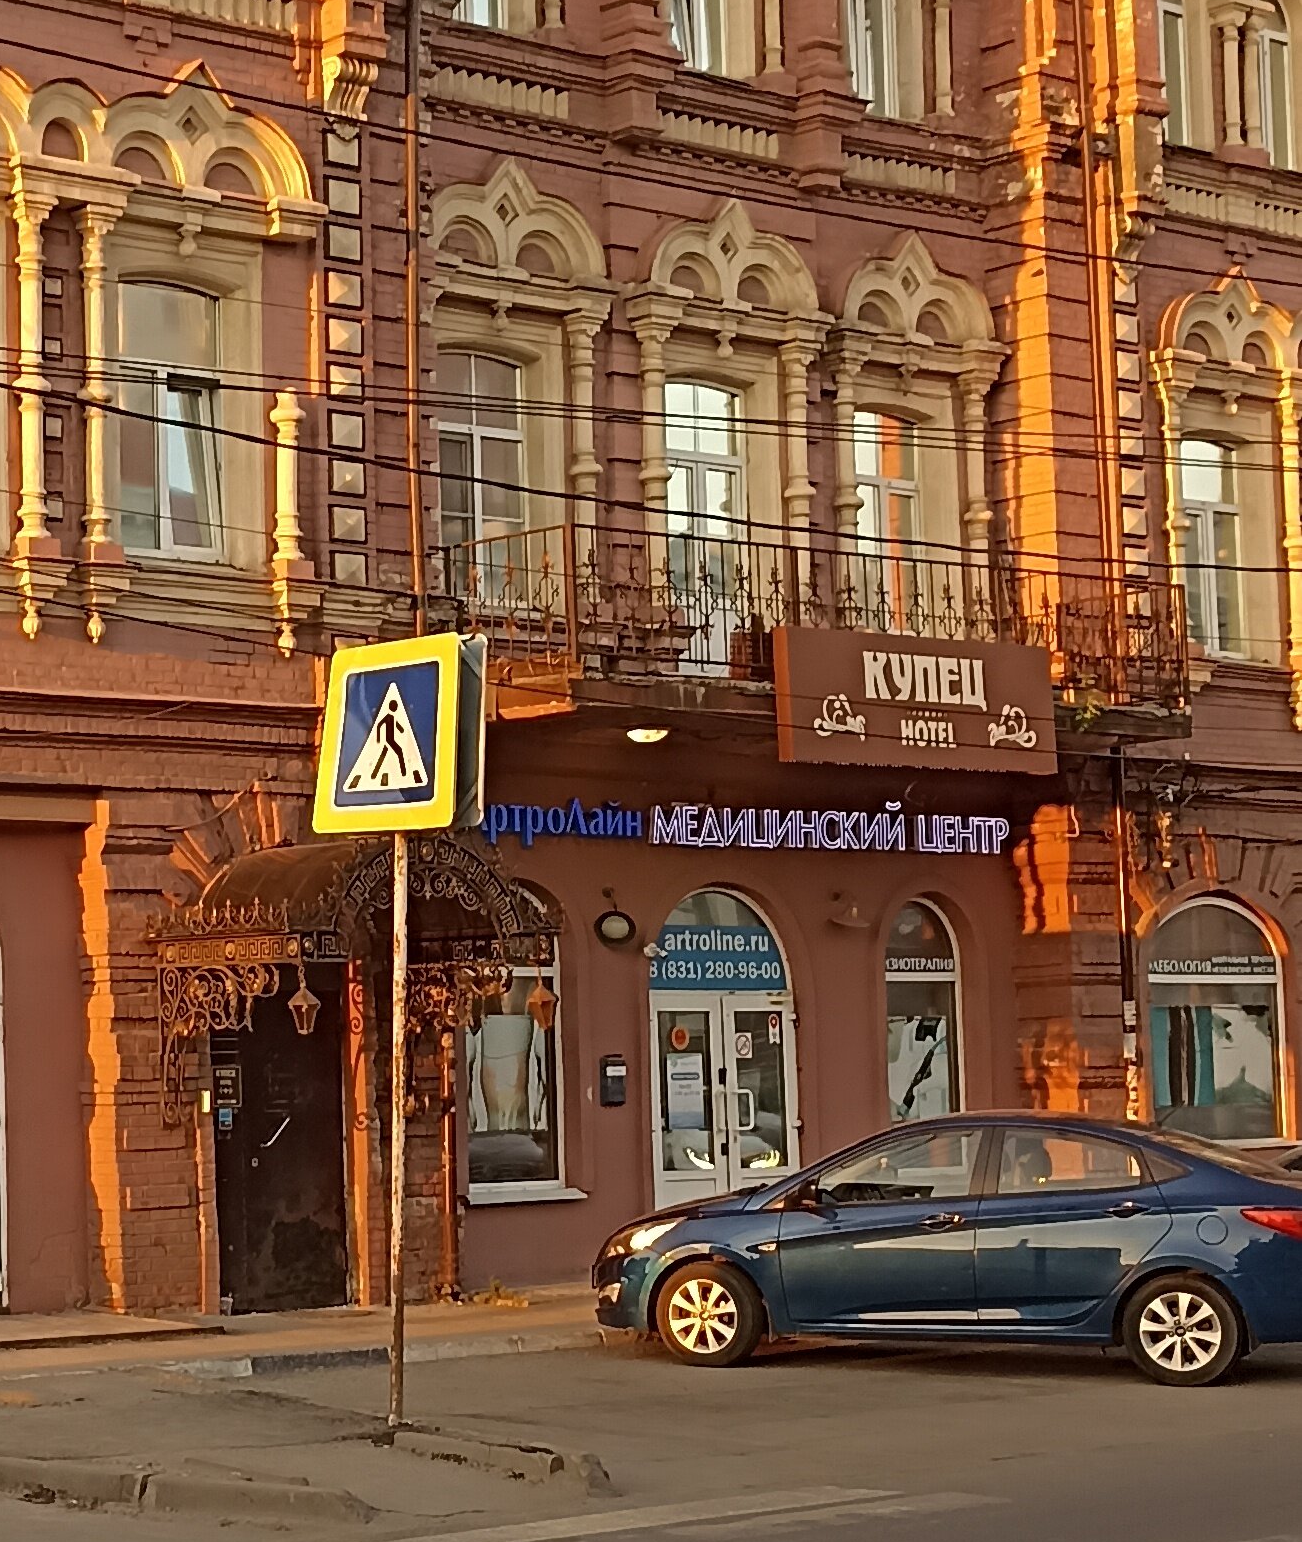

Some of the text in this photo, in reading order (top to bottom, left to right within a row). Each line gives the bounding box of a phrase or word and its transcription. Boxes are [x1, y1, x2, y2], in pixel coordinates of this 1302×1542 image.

[862, 650, 988, 712] КУПЕЦ
[900, 719, 958, 749] HOTEL
[482, 796, 1010, 854] ртроЛайн МЕДИЦИНСКИЙ ЦЕНТР
[664, 929, 769, 952] artroline.ru
[662, 960, 702, 981] (831)
[705, 961, 781, 979] 280-96-00
[1148, 959, 1212, 973] ЛЕБОЛОГИЯ
